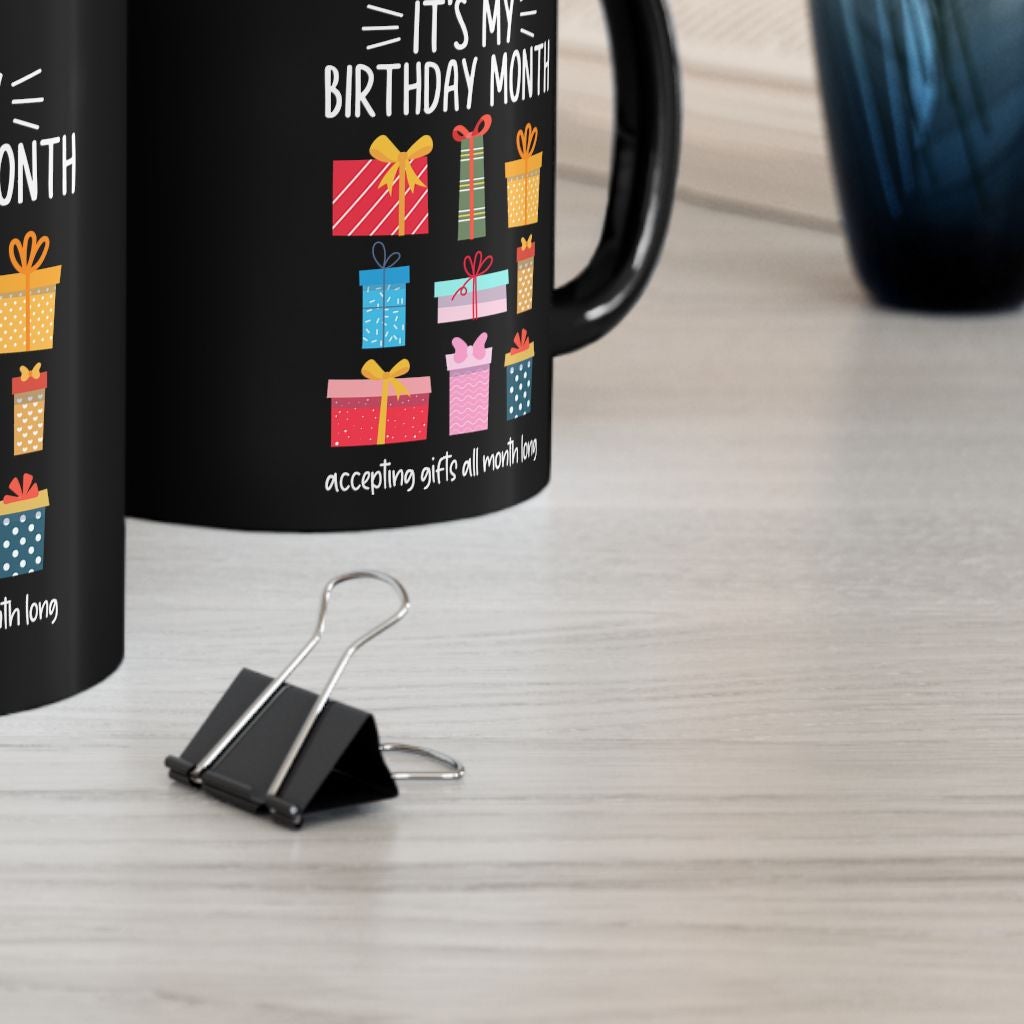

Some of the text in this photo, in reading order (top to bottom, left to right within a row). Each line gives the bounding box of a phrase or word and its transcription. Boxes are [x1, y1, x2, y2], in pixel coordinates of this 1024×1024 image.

[324, 38, 551, 119] BIRTHDAY MONTH
[324, 433, 538, 496] accepting gifts all month long
[25, 593, 59, 625] long
